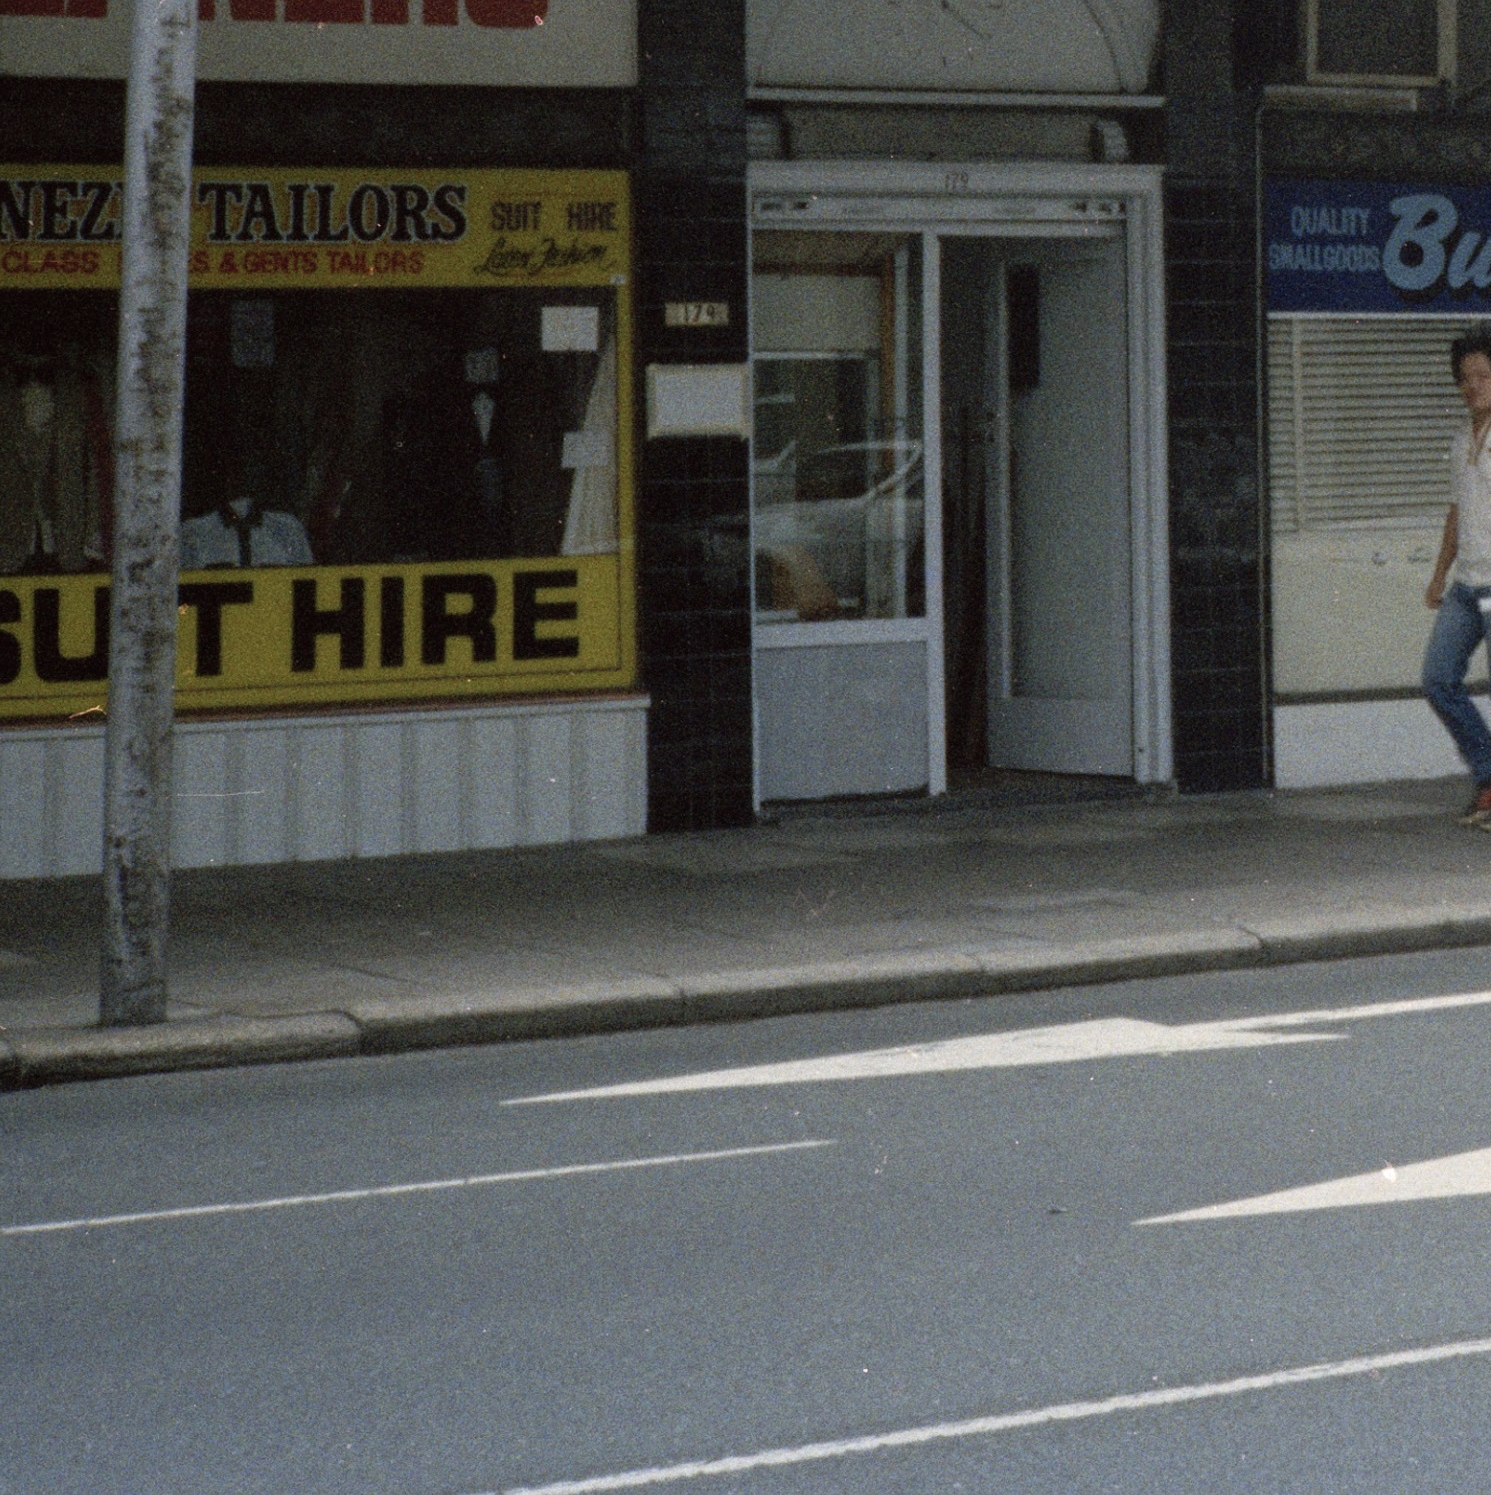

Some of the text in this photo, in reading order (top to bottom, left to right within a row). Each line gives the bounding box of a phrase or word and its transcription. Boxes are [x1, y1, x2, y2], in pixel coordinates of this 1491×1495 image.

[0, 180, 467, 243] NEZ TAILORS
[490, 201, 618, 233] SUIT HIRE
[1291, 206, 1370, 237] QUALITY
[1, 249, 99, 275] CLASS
[242, 250, 319, 275] GENTS
[328, 249, 424, 275] TAILORS
[1269, 243, 1381, 273] SMALLGOODS
[291, 569, 580, 673] HIRE
